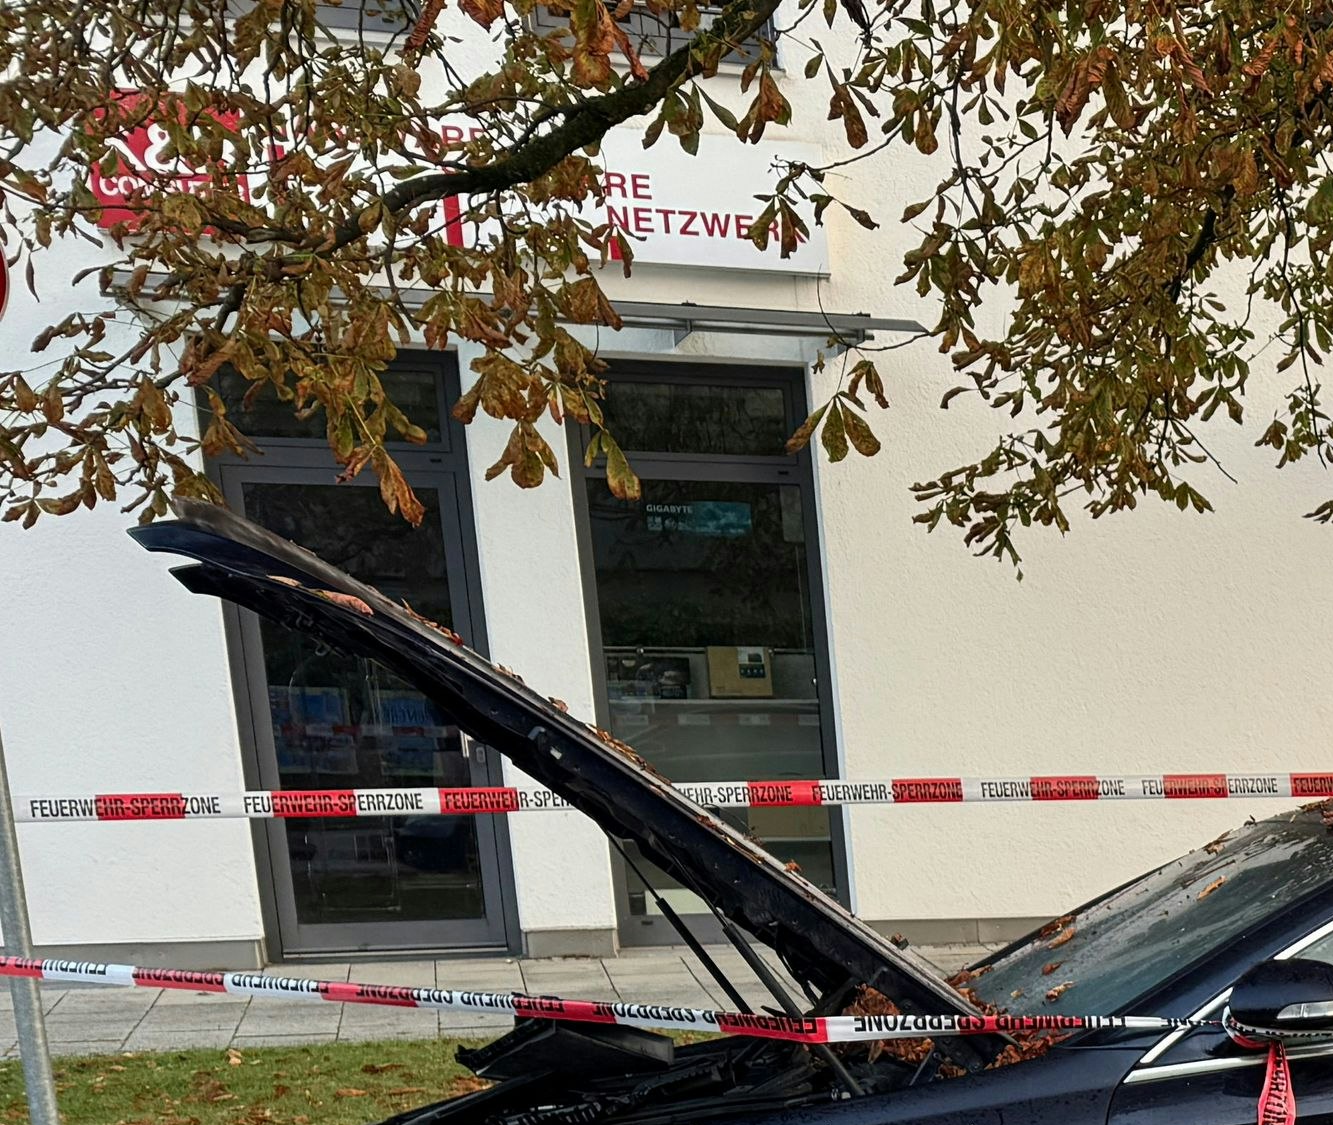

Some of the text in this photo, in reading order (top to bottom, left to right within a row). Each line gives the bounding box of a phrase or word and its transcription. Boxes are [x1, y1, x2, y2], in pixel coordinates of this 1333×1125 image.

[646, 504, 693, 514] GIGABYTE
[812, 782, 963, 801] FEUERWEHR-SPERRZONE
[981, 779, 1125, 798] FEUERWEHR-SPERRZONE
[1142, 777, 1277, 796] FEUERWEHR-SPERRZONE
[30, 796, 221, 818] FEUERWEHR-SPERRZONE
[244, 792, 423, 814] FEUERWEHR-SPERRZONE
